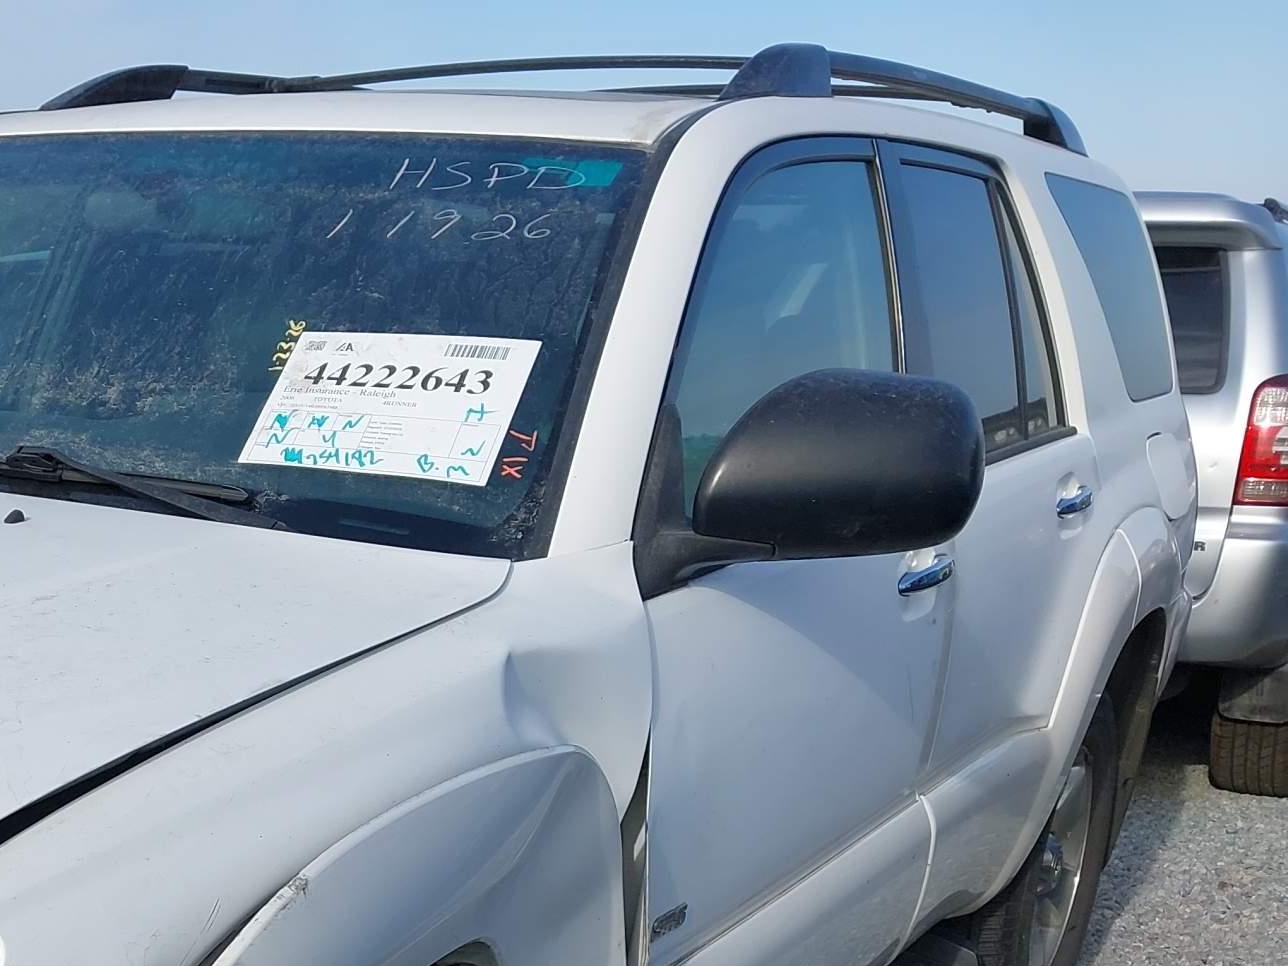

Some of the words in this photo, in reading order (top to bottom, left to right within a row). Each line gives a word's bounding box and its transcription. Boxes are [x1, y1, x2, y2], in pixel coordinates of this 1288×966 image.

[390, 157, 586, 190] HSPD
[303, 361, 495, 396] 44222643
[305, 385, 351, 397] Insurance
[359, 388, 398, 399] Raleigh
